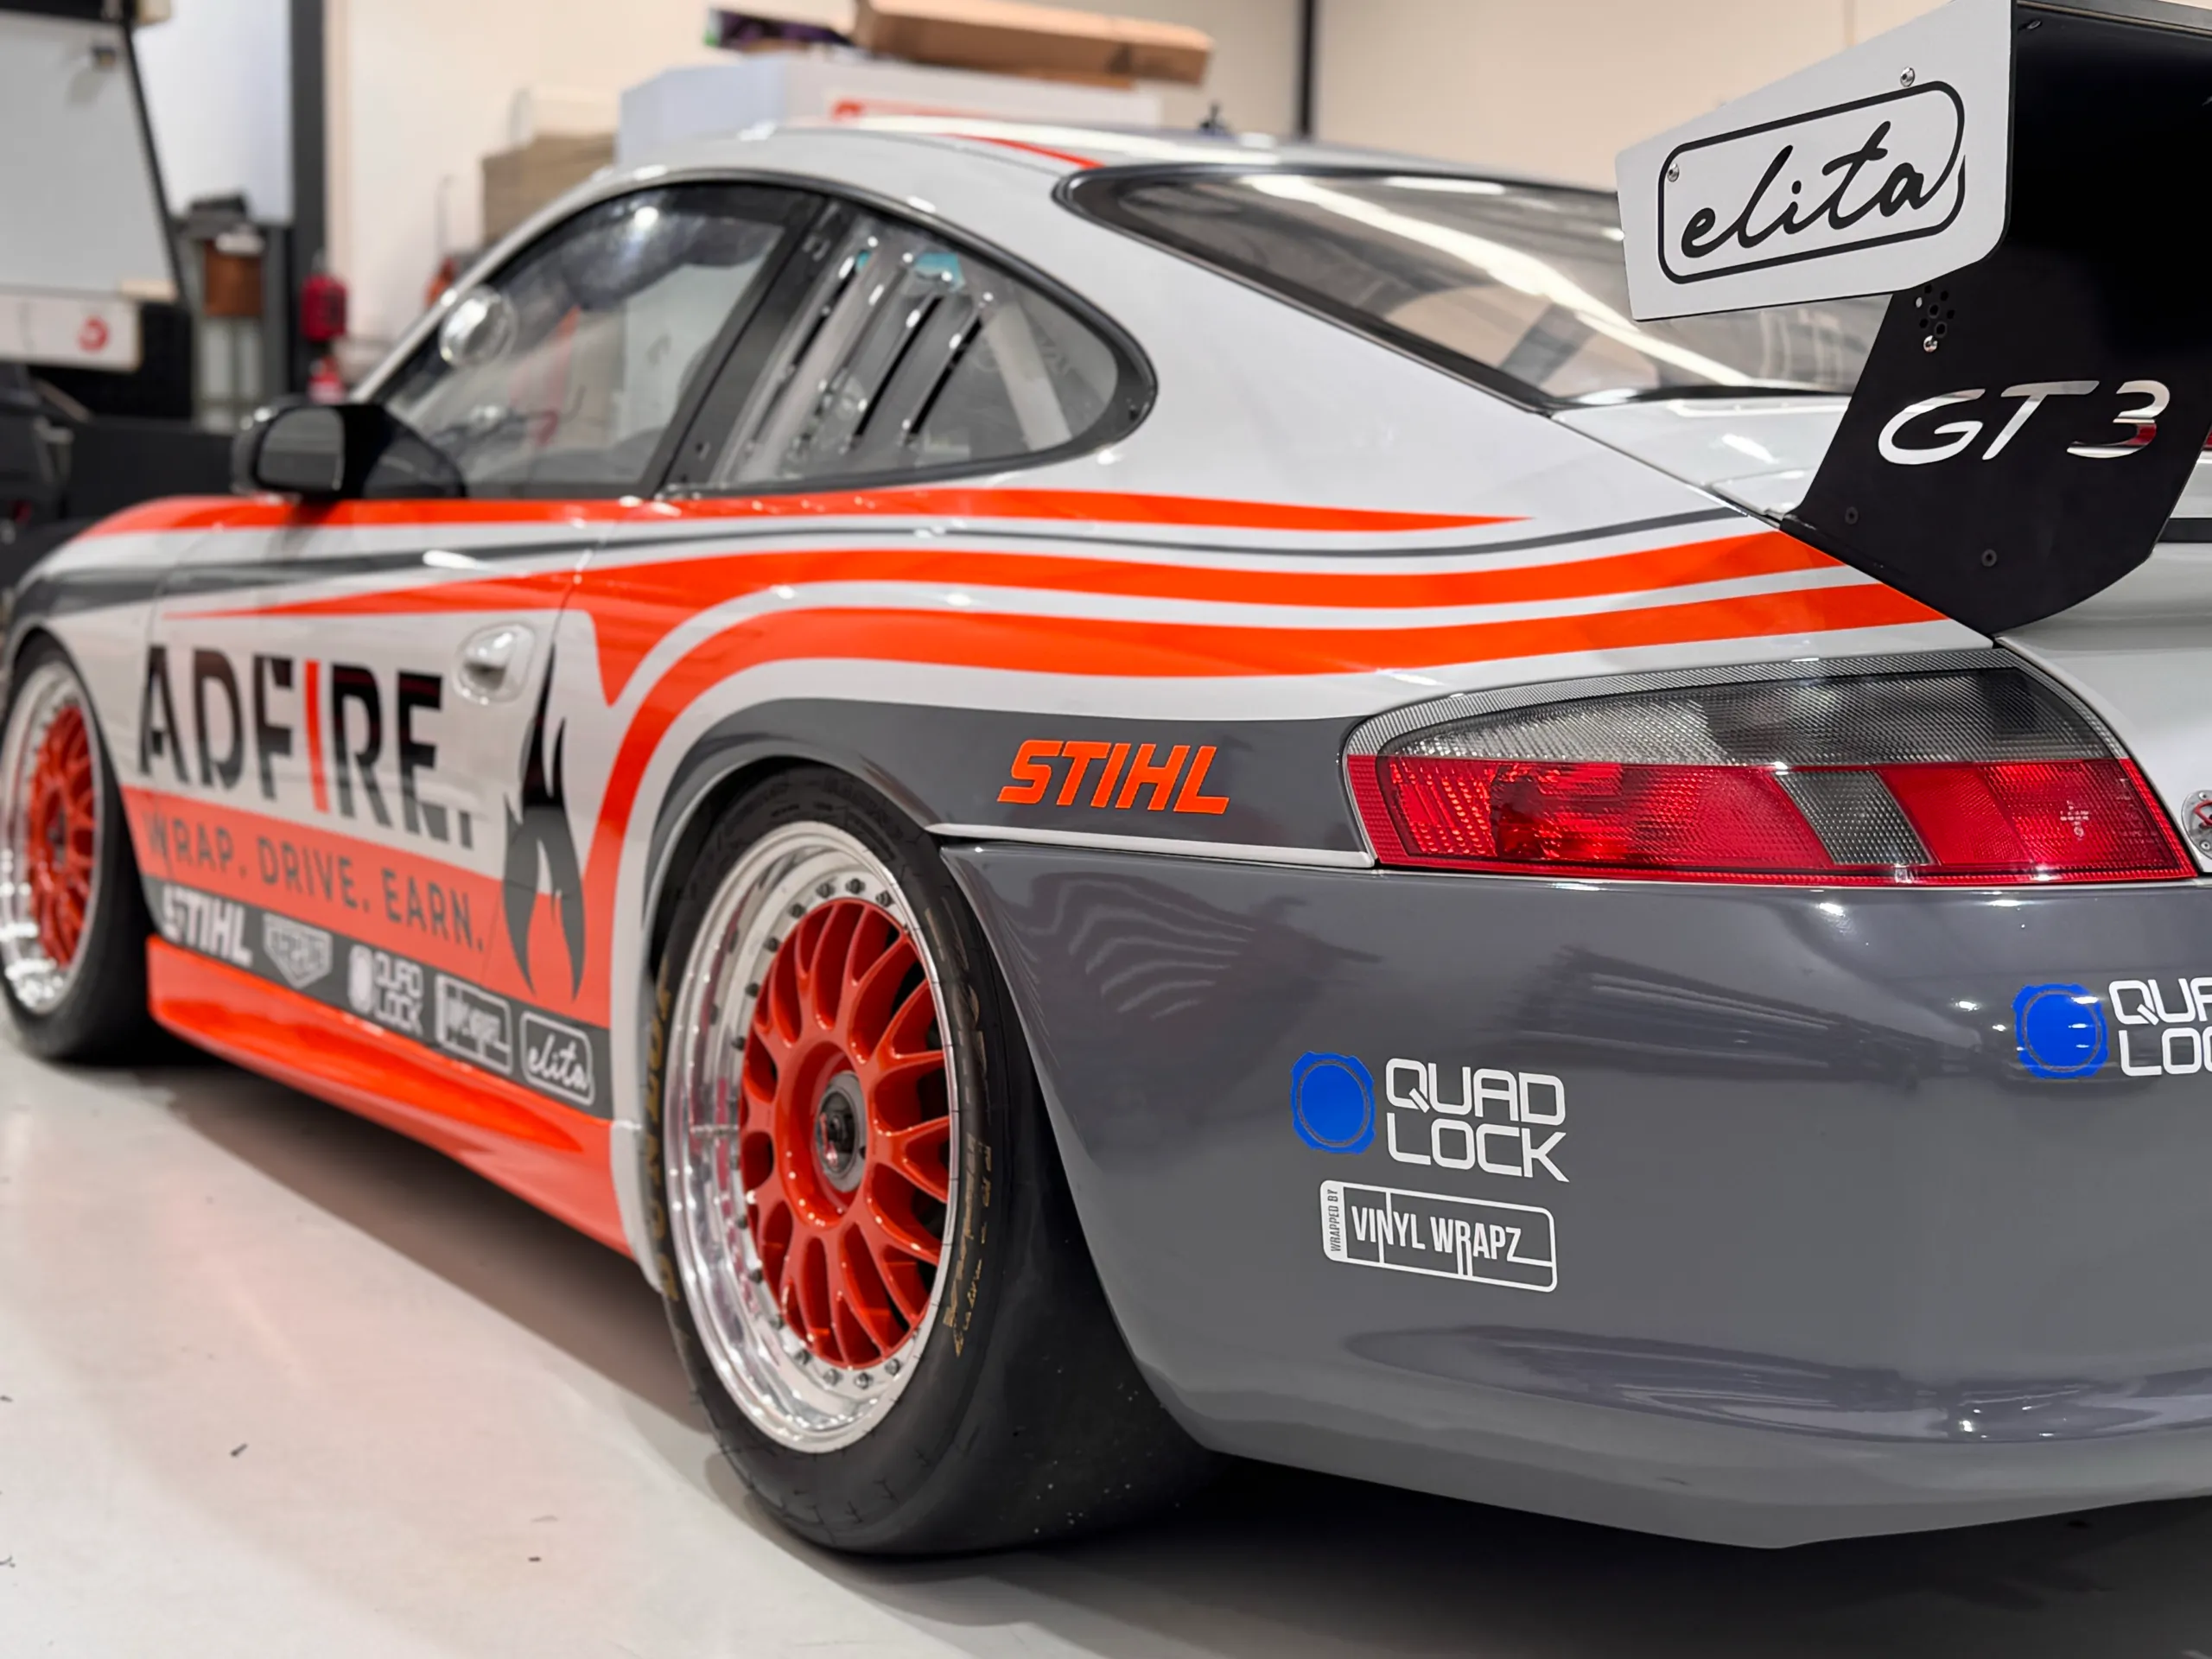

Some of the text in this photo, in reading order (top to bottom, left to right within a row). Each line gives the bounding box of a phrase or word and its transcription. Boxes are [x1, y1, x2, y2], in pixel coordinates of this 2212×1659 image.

[1681, 120, 1936, 258] elita
[997, 740, 1230, 814] STIHL
[142, 810, 247, 880] WRAP.
[257, 836, 370, 912] DRIVE.
[383, 868, 484, 952] EARN.
[162, 883, 253, 968] STIHL
[2119, 1027, 2212, 1077] LO
[1385, 1058, 1567, 1125] QUAD
[1386, 1112, 1570, 1183] LOCK
[1327, 1189, 1341, 1251] WRAPPED BY
[1351, 1205, 1522, 1264] VINYL WRAPZ
